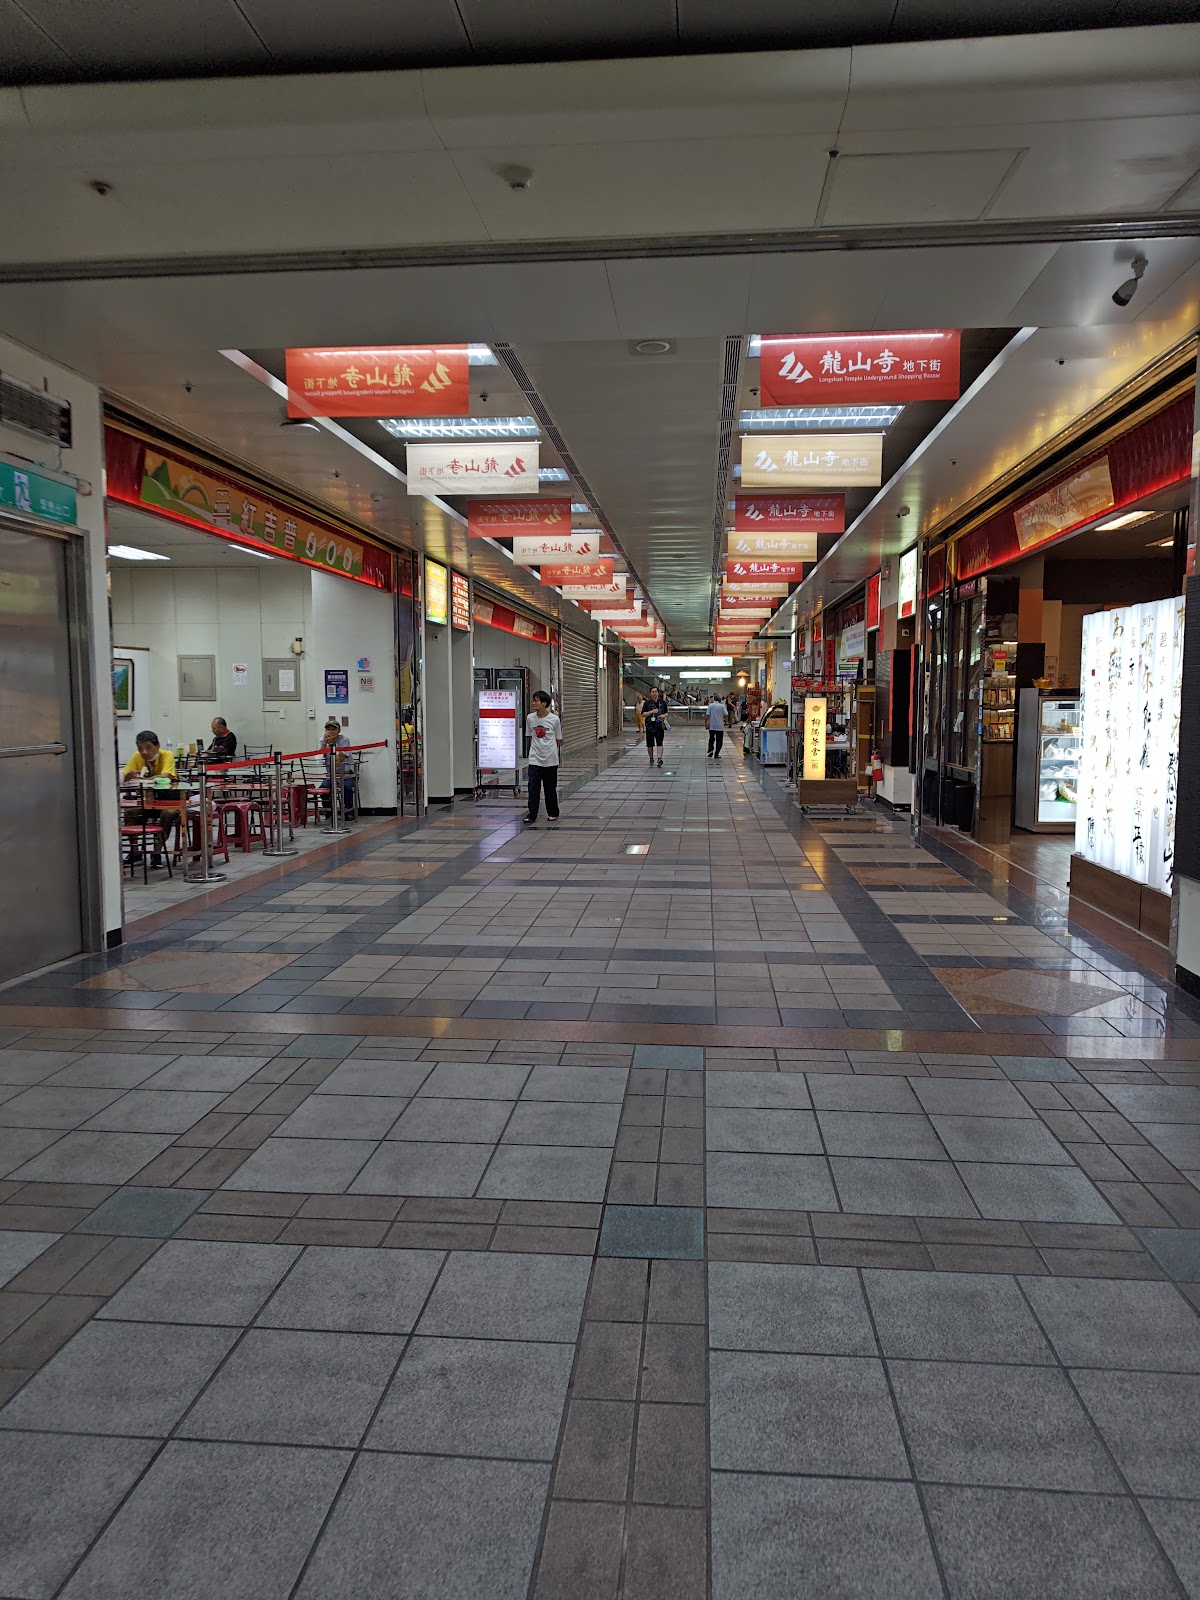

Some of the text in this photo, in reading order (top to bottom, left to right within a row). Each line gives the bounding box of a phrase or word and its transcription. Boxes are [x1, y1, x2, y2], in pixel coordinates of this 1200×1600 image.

[818, 348, 941, 374] 龍山寺 地下街
[864, 374, 896, 382] Underground
[782, 450, 869, 467] 龍山寺 地下街
[768, 504, 812, 517] 龍山寺
[240, 498, 297, 551] 紅吉普
[755, 538, 790, 549] 龍山寺
[749, 563, 780, 573] 龍山寺
